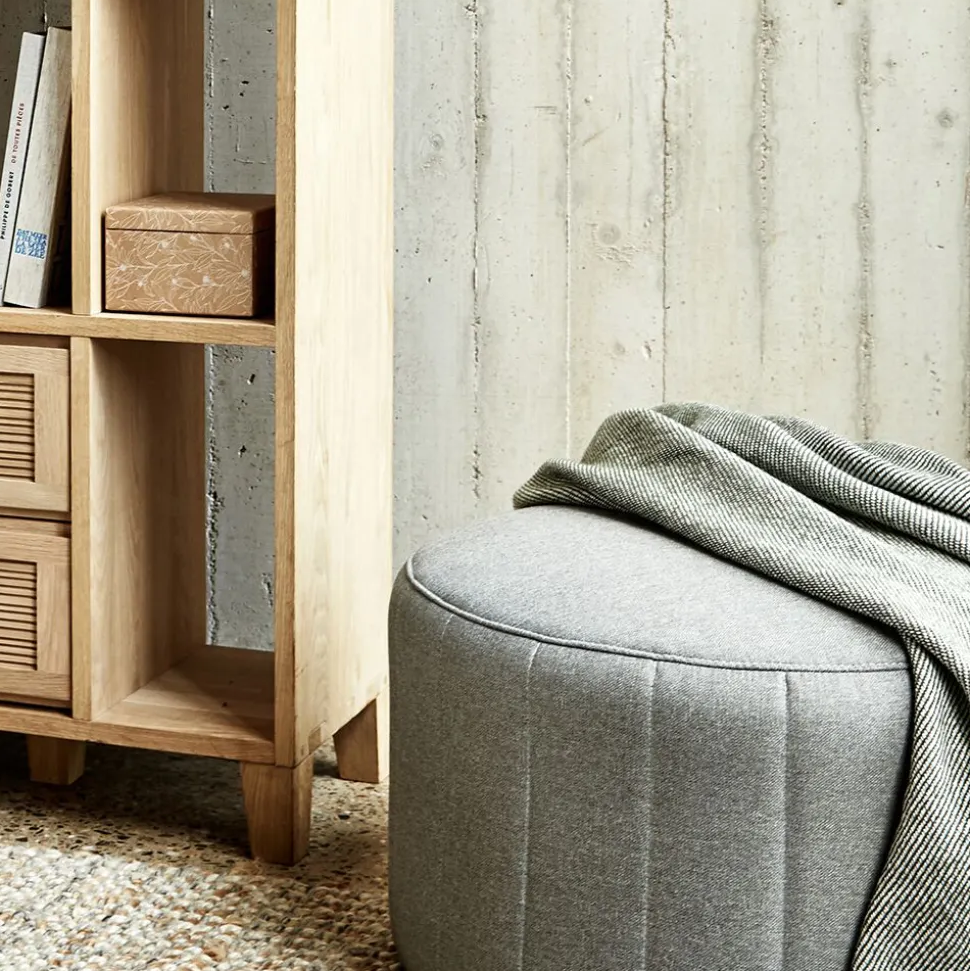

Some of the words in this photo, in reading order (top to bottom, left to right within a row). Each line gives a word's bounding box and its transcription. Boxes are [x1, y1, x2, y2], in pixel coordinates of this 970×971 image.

[16, 102, 25, 127] PIÈCES
[12, 128, 21, 153] TOUTES
[11, 155, 17, 164] DE
[5, 171, 14, 198] GOBERT
[4, 200, 10, 209] DE
[0, 211, 9, 240] PHILIPPE
